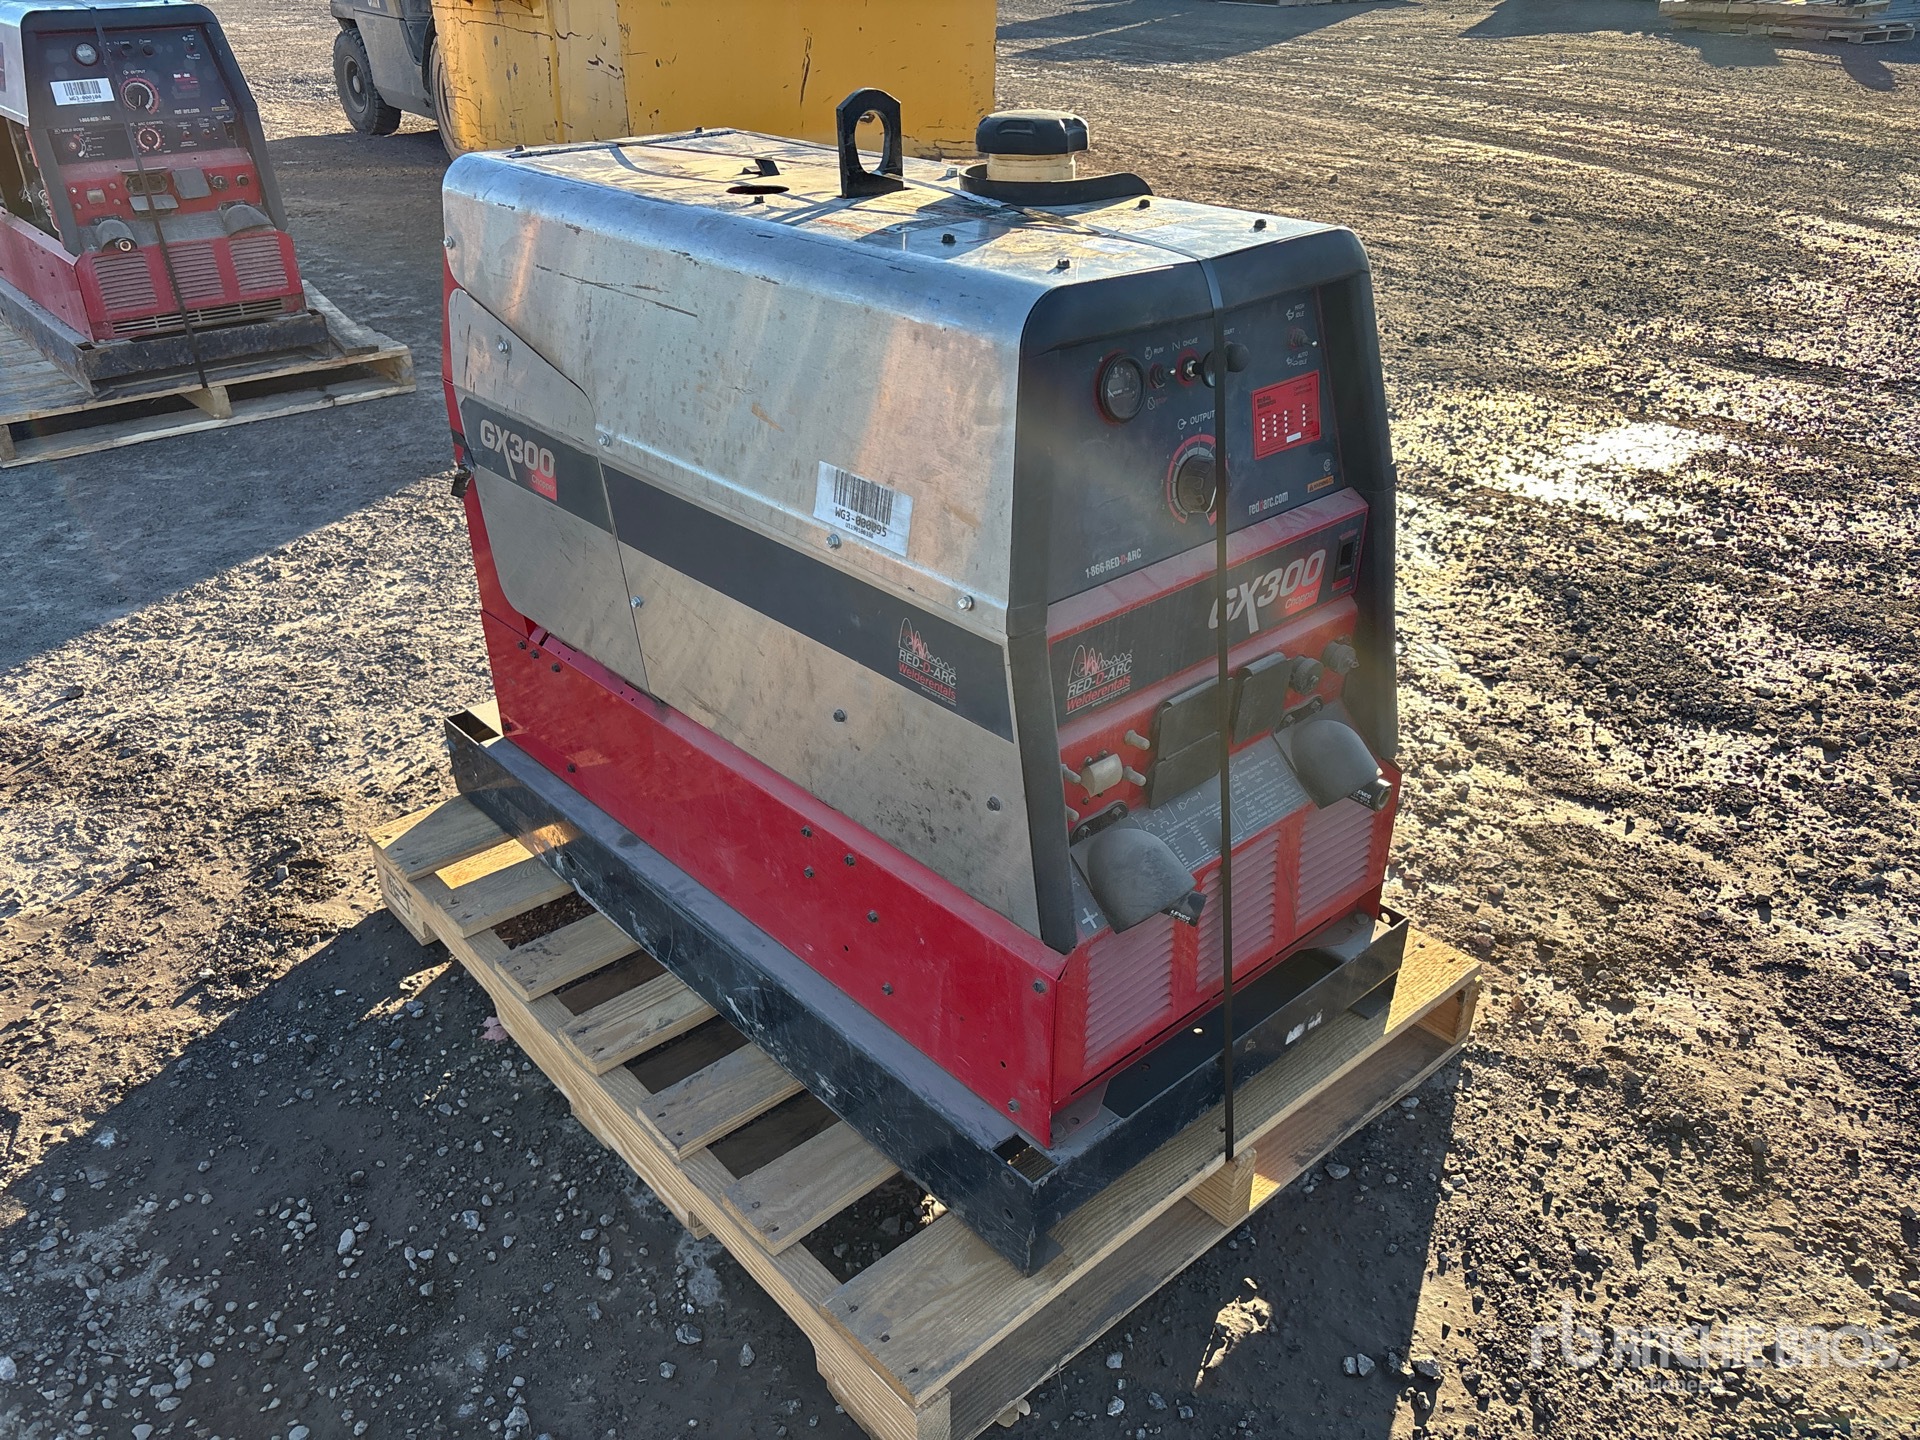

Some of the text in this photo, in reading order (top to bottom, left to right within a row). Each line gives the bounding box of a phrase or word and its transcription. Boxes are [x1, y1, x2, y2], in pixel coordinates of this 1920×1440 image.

[1189, 409, 1216, 425] OUTPUT
[480, 419, 556, 480] GX300
[834, 506, 888, 538] WG3-000095
[1208, 549, 1326, 634] GX300
[898, 649, 957, 687] RED-D-ARC
[898, 662, 957, 701] Welderentals
[1067, 659, 1133, 699] RED-D-ARC
[1066, 675, 1132, 712] Welderentals
